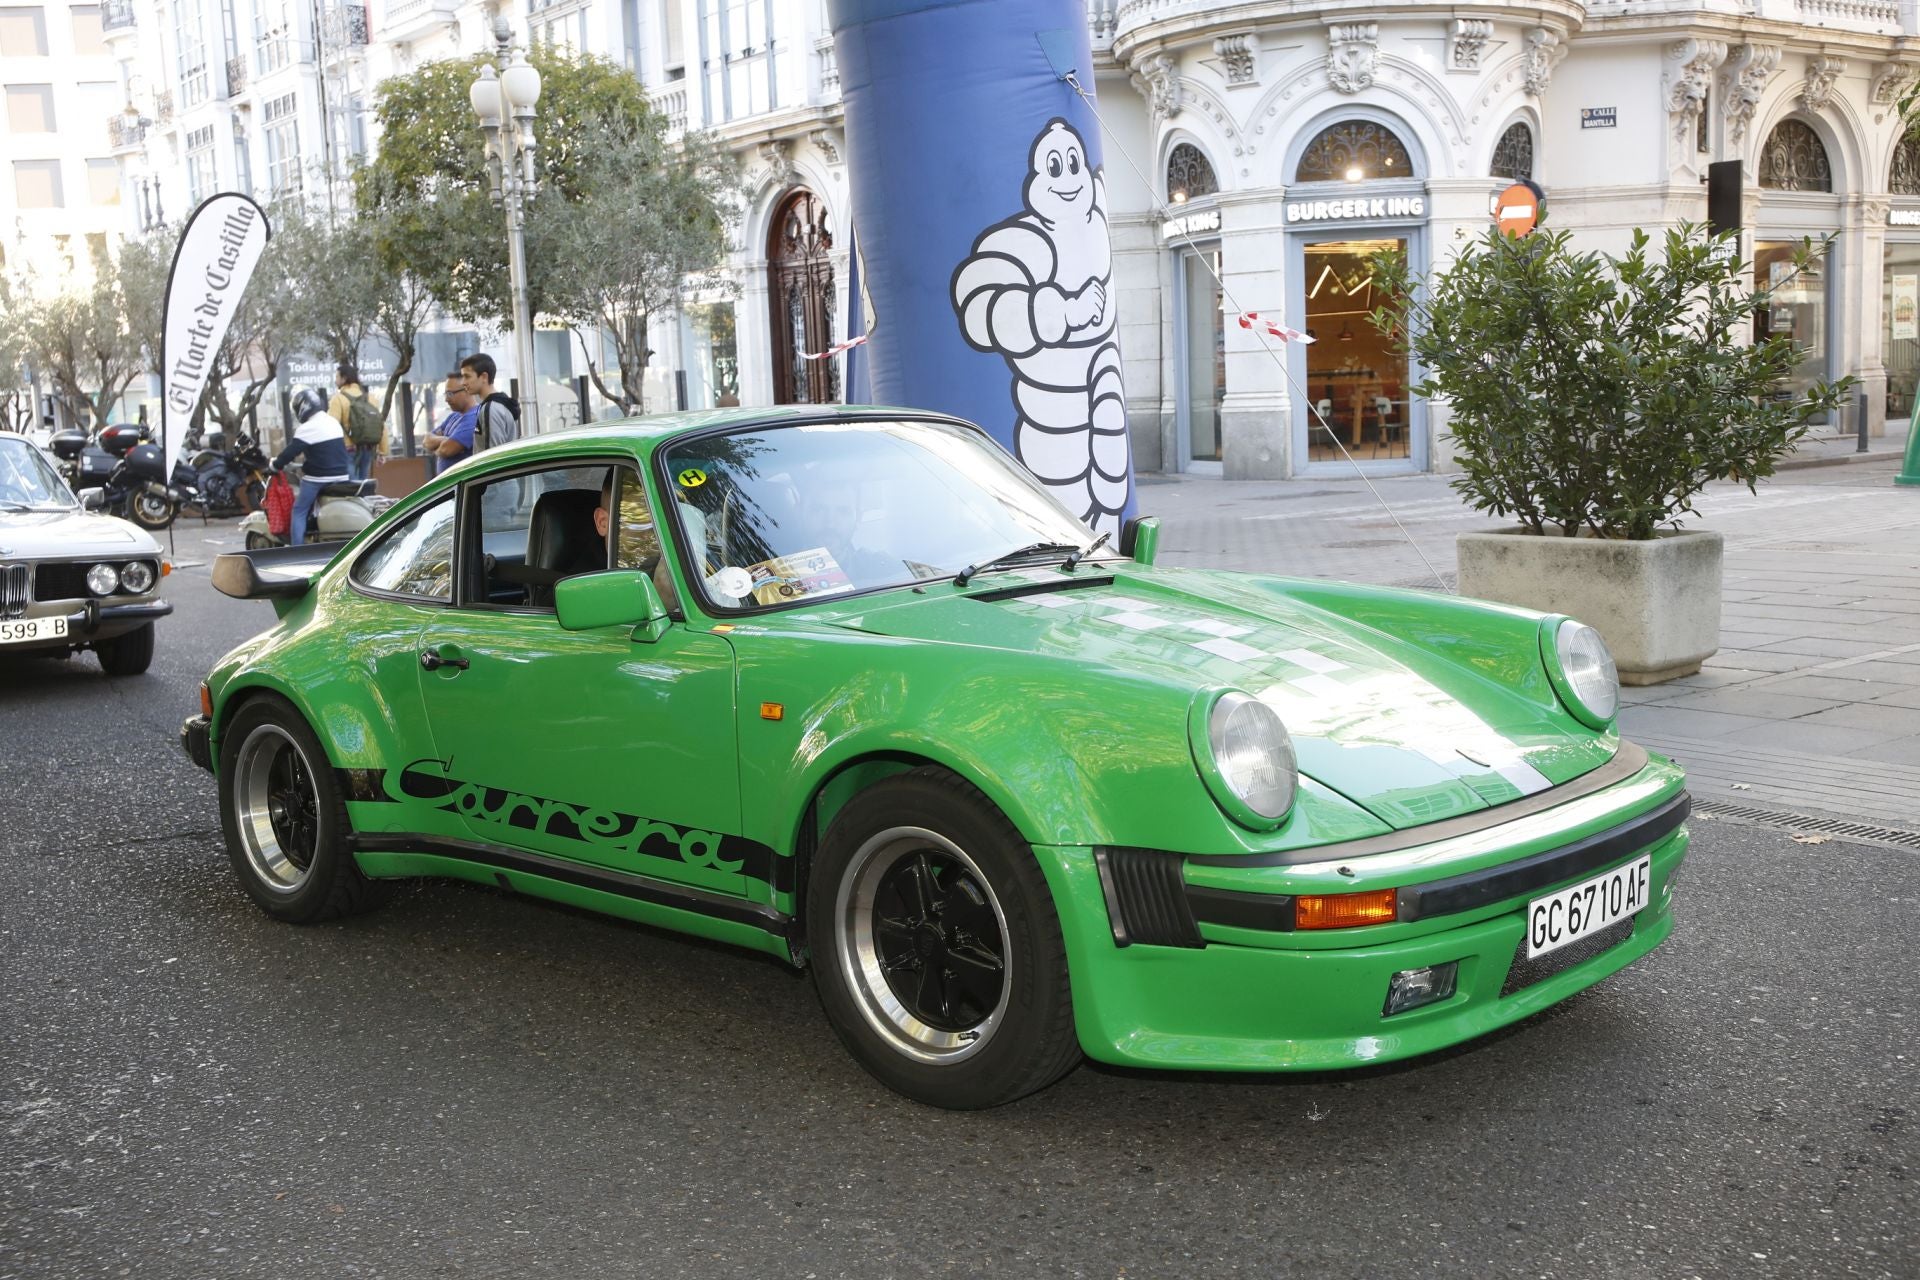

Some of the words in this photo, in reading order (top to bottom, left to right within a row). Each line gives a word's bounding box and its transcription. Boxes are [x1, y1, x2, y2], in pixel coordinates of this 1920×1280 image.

[1593, 108, 1616, 117] CALLE
[1287, 201, 1369, 222] BURGER
[1370, 198, 1424, 217] KING
[205, 205, 256, 291] Castilla
[194, 292, 223, 318] de
[174, 319, 214, 382] Norte
[288, 362, 316, 373] Todo
[289, 373, 331, 384] cuando
[169, 382, 197, 415] El
[682, 470, 703, 486] H
[807, 556, 826, 571] 43
[1, 622, 37, 640] 599
[54, 618, 66, 635] B
[383, 755, 745, 873] Carrera
[1531, 898, 1563, 949] GC
[1568, 874, 1623, 935] 6710
[1625, 861, 1649, 911] AF
